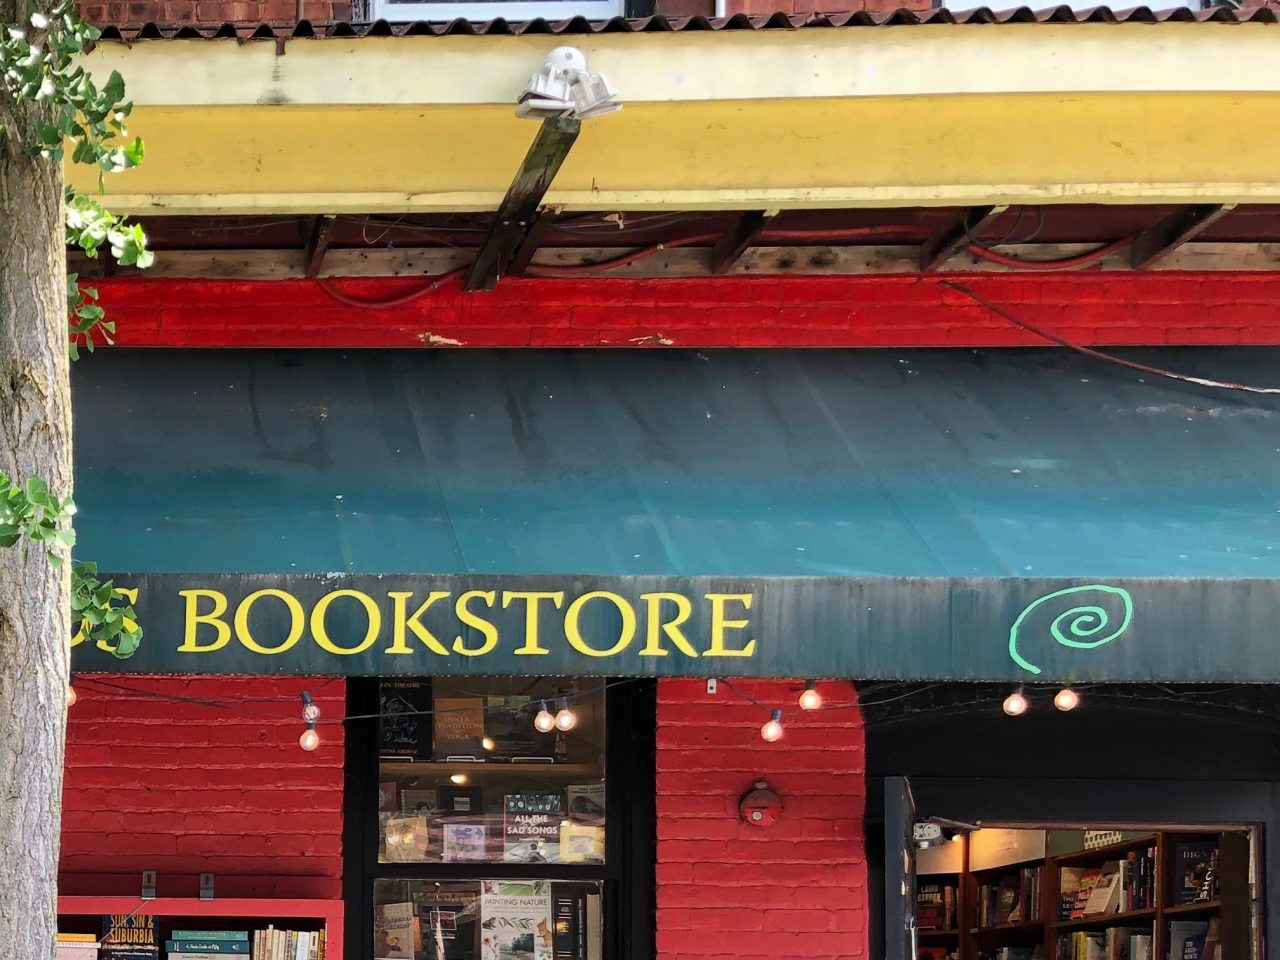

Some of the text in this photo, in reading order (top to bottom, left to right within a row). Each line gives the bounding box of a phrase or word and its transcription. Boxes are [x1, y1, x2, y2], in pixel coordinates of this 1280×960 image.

[178, 588, 757, 658] BOOKSTORE
[514, 814, 549, 823] ALL THE
[507, 826, 558, 835] SAD SONGS
[484, 898, 548, 906] PAINTING NATURE
[131, 915, 145, 929] SIN
[147, 915, 154, 929] &
[109, 928, 154, 944] SUBURBIA
